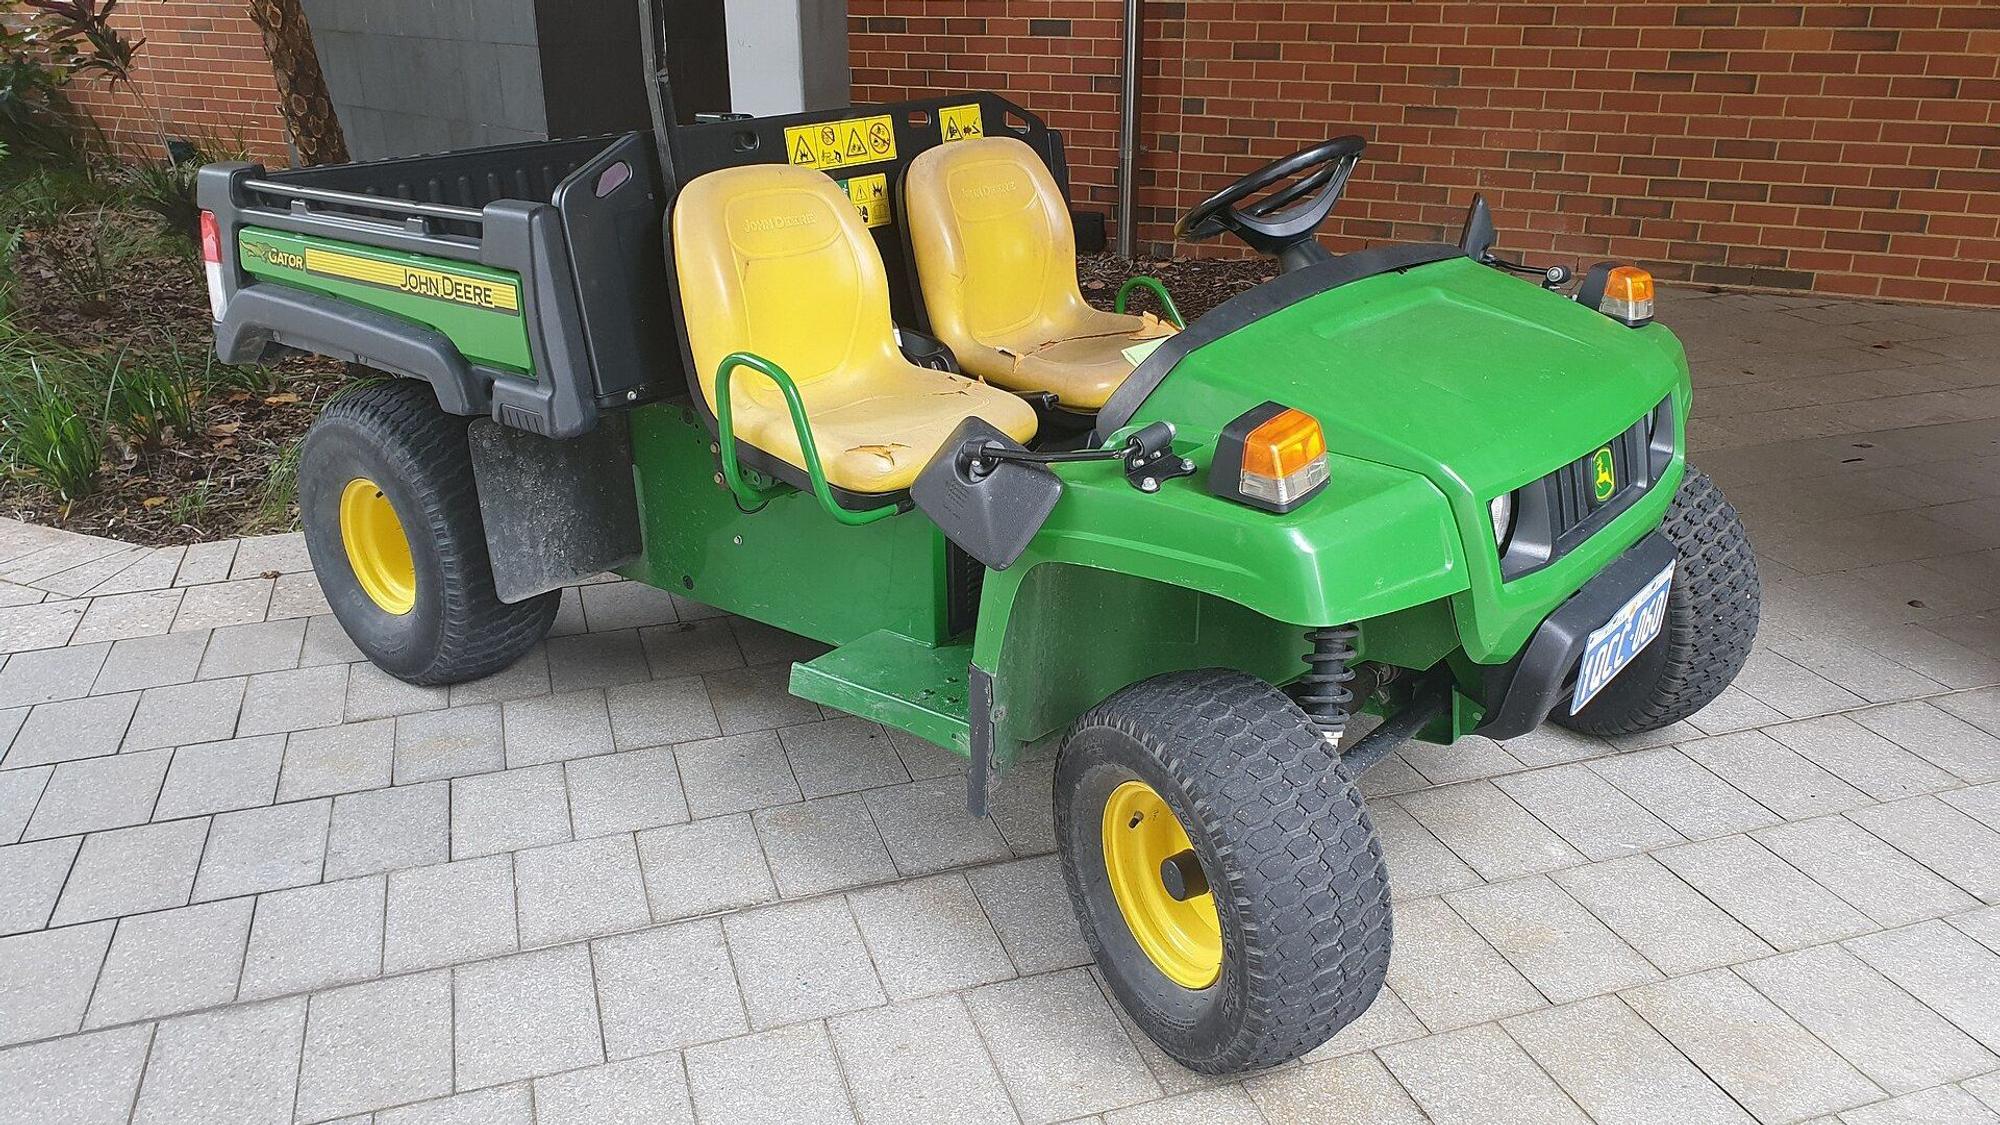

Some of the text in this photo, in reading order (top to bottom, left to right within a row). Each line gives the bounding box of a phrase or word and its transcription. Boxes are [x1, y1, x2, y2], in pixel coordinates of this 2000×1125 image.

[775, 211, 817, 229] DEERE
[268, 247, 304, 270] GATOR
[400, 268, 493, 305] JOHN DEERE
